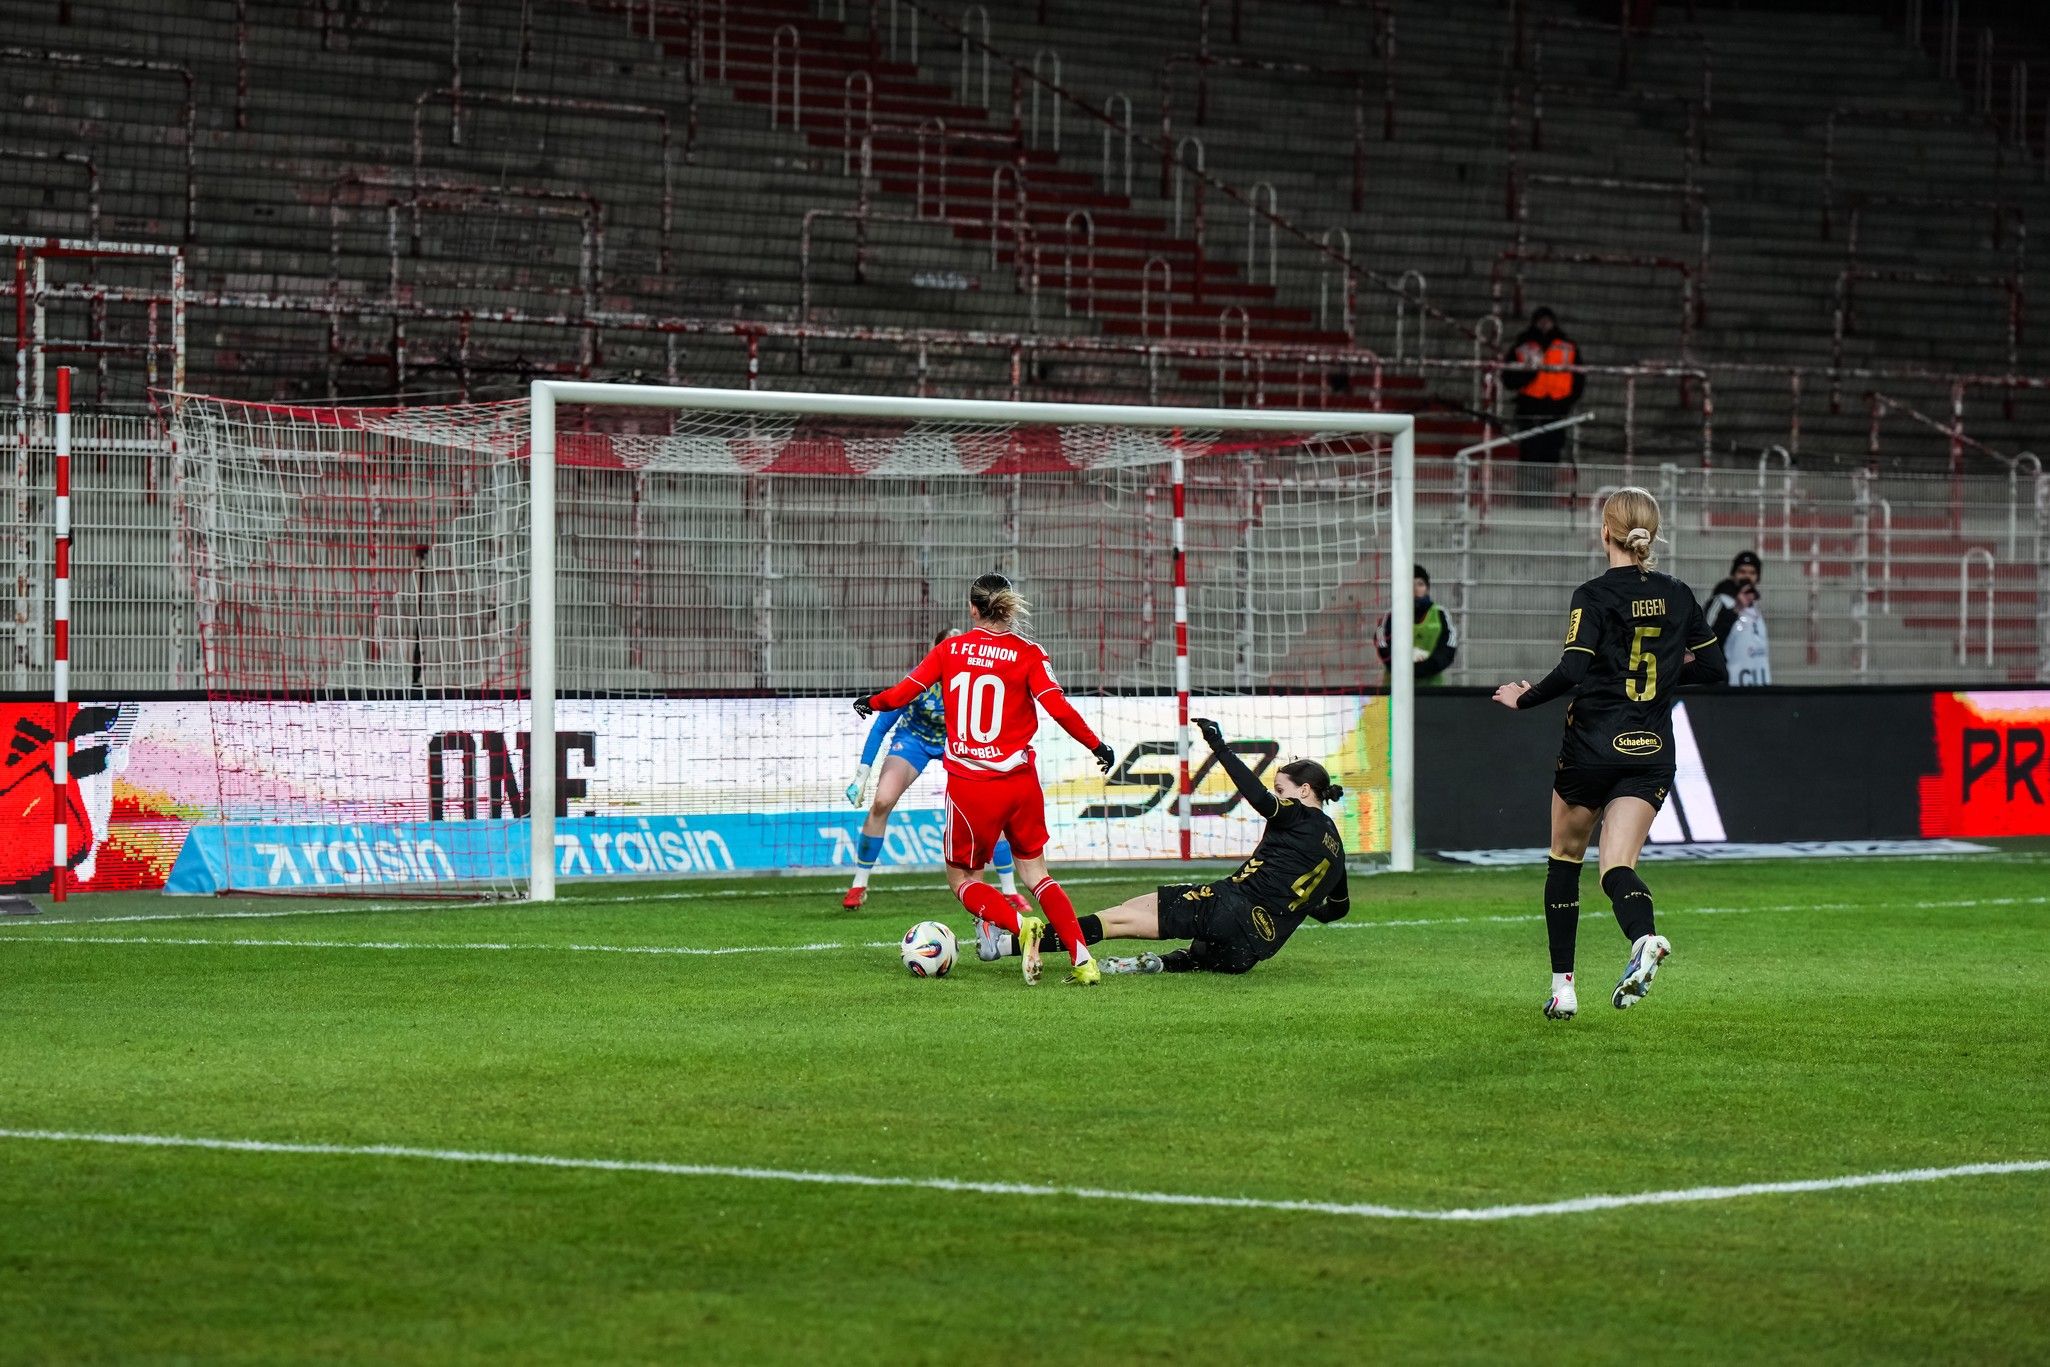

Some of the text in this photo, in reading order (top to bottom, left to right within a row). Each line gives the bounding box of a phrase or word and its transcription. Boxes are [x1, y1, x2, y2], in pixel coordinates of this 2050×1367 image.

[1632, 599, 1666, 618] DEGEN
[950, 642, 1018, 662] 1. FC UNION
[967, 656, 994, 668] BERLIN
[1625, 626, 1662, 702] 5
[949, 671, 1006, 744] 10
[1618, 737, 1658, 746] Schaebens
[1962, 728, 2050, 805] PR
[301, 827, 457, 885] raisin
[590, 817, 736, 875] raisin
[1288, 858, 1331, 912] 4
